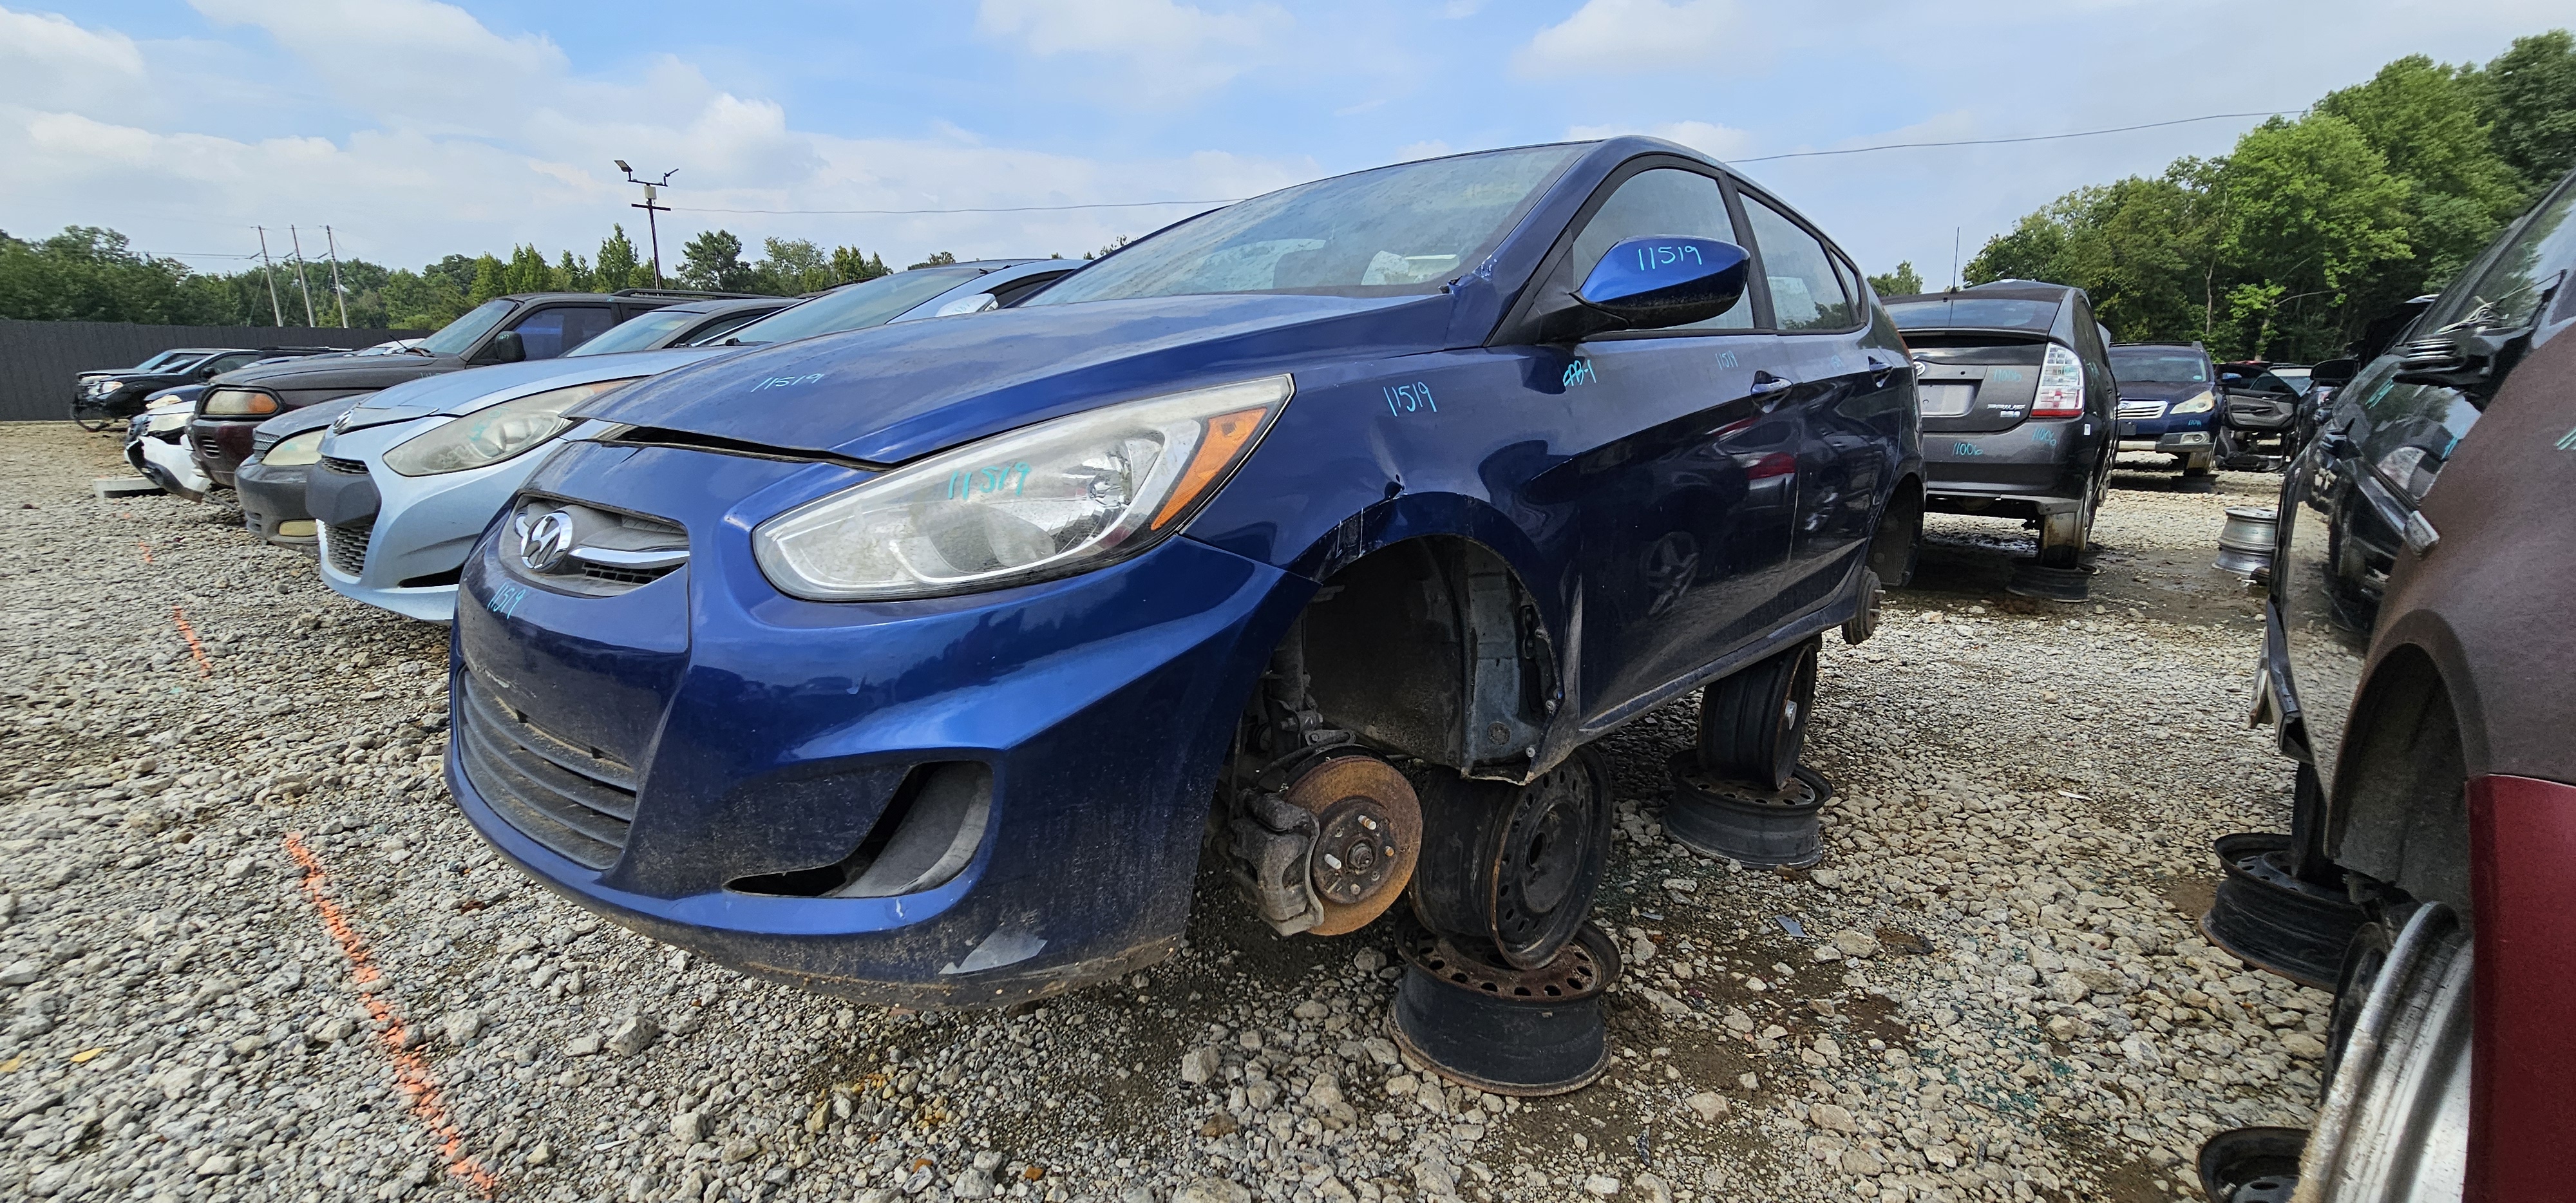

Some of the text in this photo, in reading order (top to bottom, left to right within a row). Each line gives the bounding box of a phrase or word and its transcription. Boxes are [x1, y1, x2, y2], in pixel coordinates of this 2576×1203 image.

[1638, 245, 1702, 271] 11519
[1715, 350, 1738, 371] 11519
[750, 373, 825, 393] 11519
[1383, 381, 1437, 417] 11519
[1952, 442, 1984, 457] 11006
[947, 461, 1032, 500] 11519
[486, 582, 526, 620] 11519
